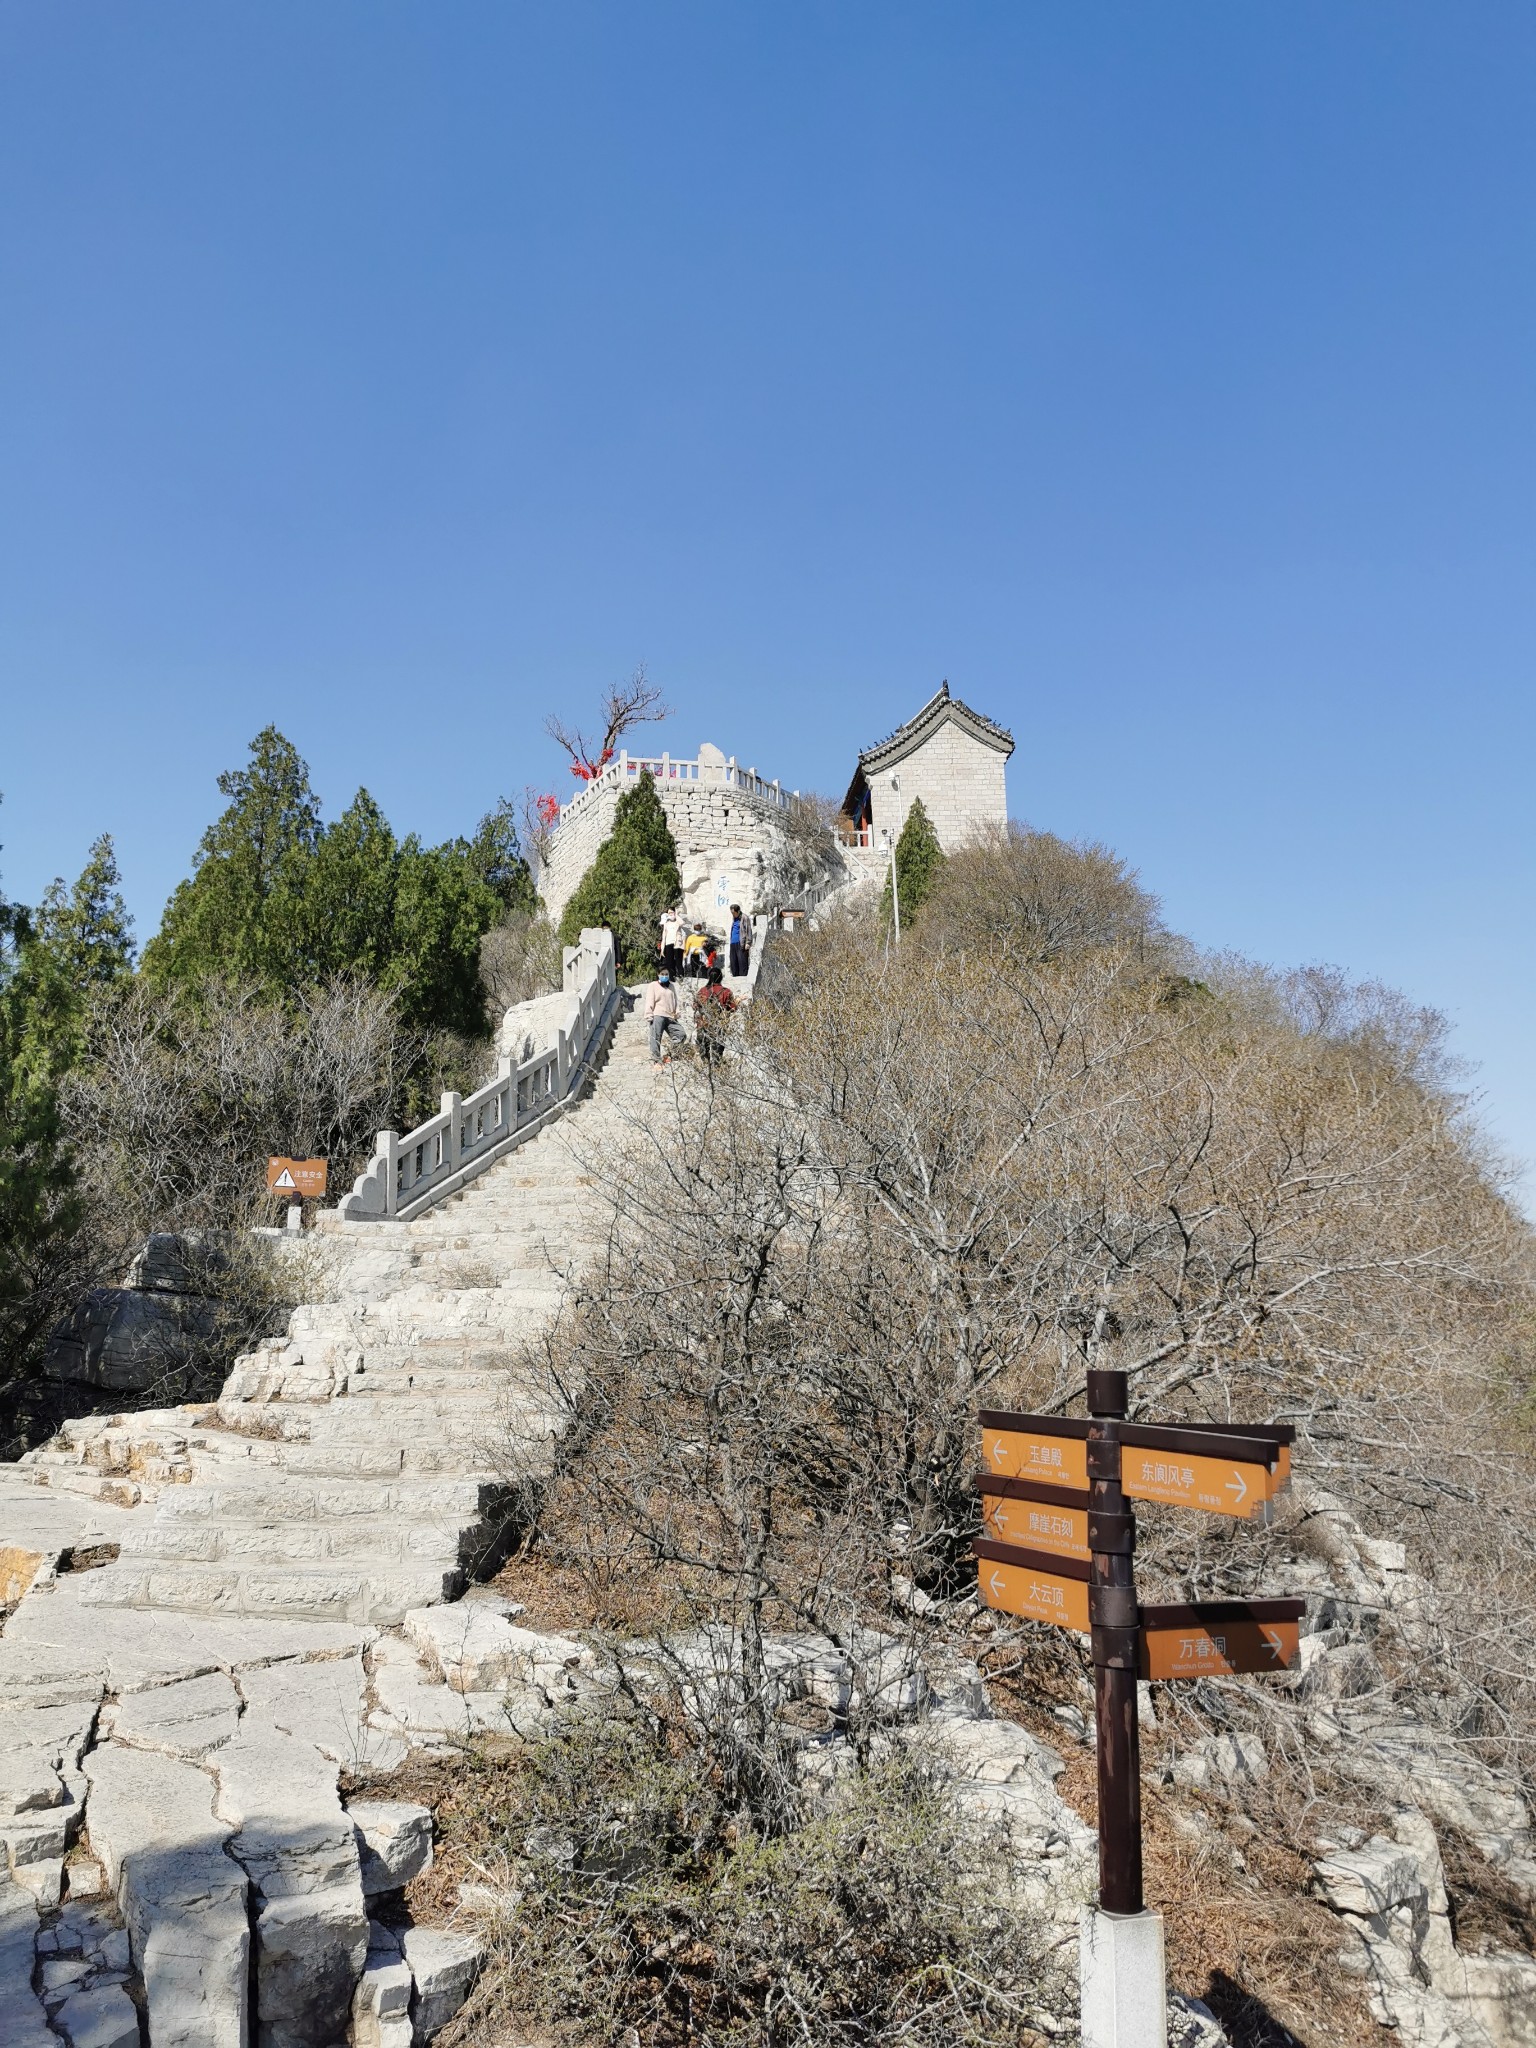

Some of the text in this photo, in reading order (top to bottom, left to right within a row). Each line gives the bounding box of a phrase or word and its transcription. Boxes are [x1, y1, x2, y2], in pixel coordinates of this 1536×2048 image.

[1029, 1445, 1062, 1467] 玉皇殿
[1142, 1460, 1195, 1489] 东阆风亭
[1029, 1512, 1073, 1538] 摩崖石刻
[1029, 1580, 1064, 1607] 大云顶
[1179, 1636, 1226, 1659] 万春洞
